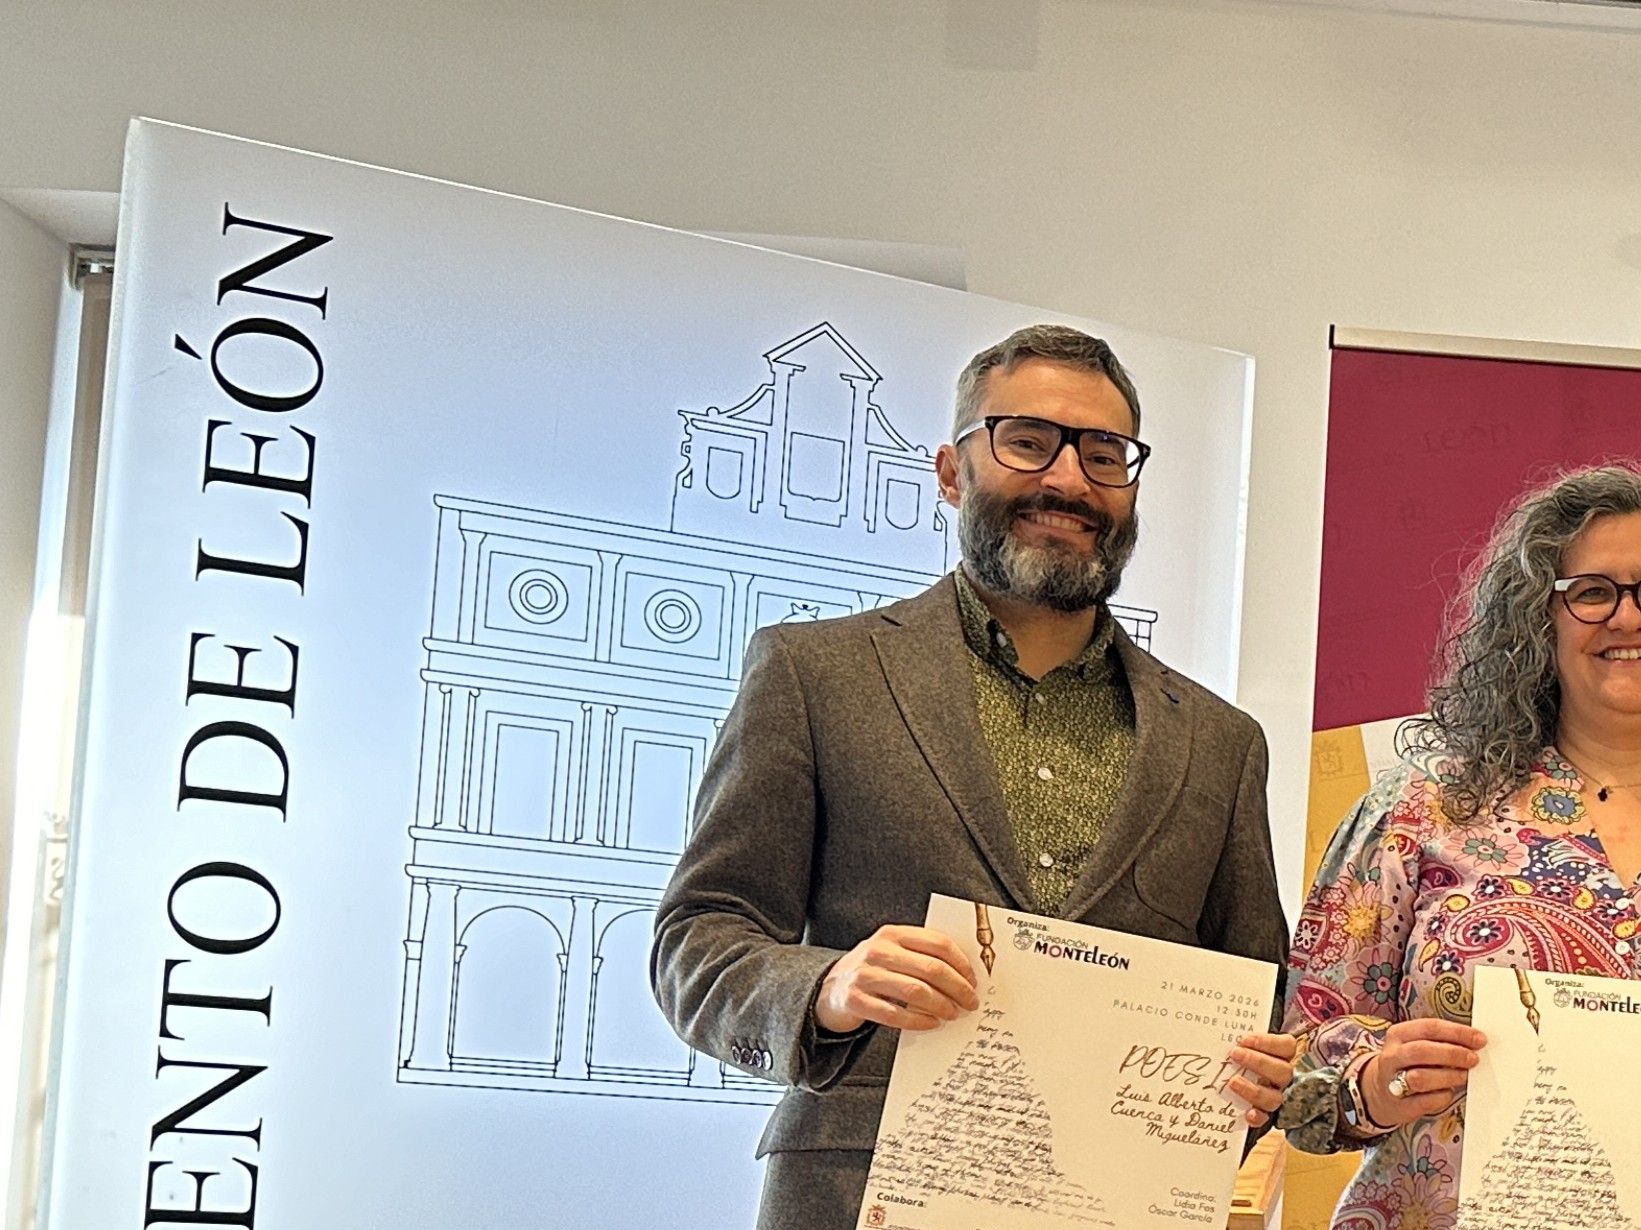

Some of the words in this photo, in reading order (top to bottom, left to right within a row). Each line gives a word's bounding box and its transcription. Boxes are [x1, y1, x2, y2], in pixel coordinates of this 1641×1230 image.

[175, 201, 334, 597] LEÓN
[177, 632, 300, 824] DE
[1112, 999, 1169, 1017] PALACIO
[1175, 1011, 1218, 1027] CONDE
[1224, 1021, 1254, 1033] LUNA
[1110, 1100, 1164, 1122] Cuenca
[1169, 1114, 1179, 1128] y
[1185, 1112, 1236, 1133] Daniel
[1116, 1084, 1151, 1103] Luis
[1158, 1092, 1213, 1113] Alberto
[1219, 1101, 1236, 1118] de
[877, 1191, 928, 1208] Colabora:
